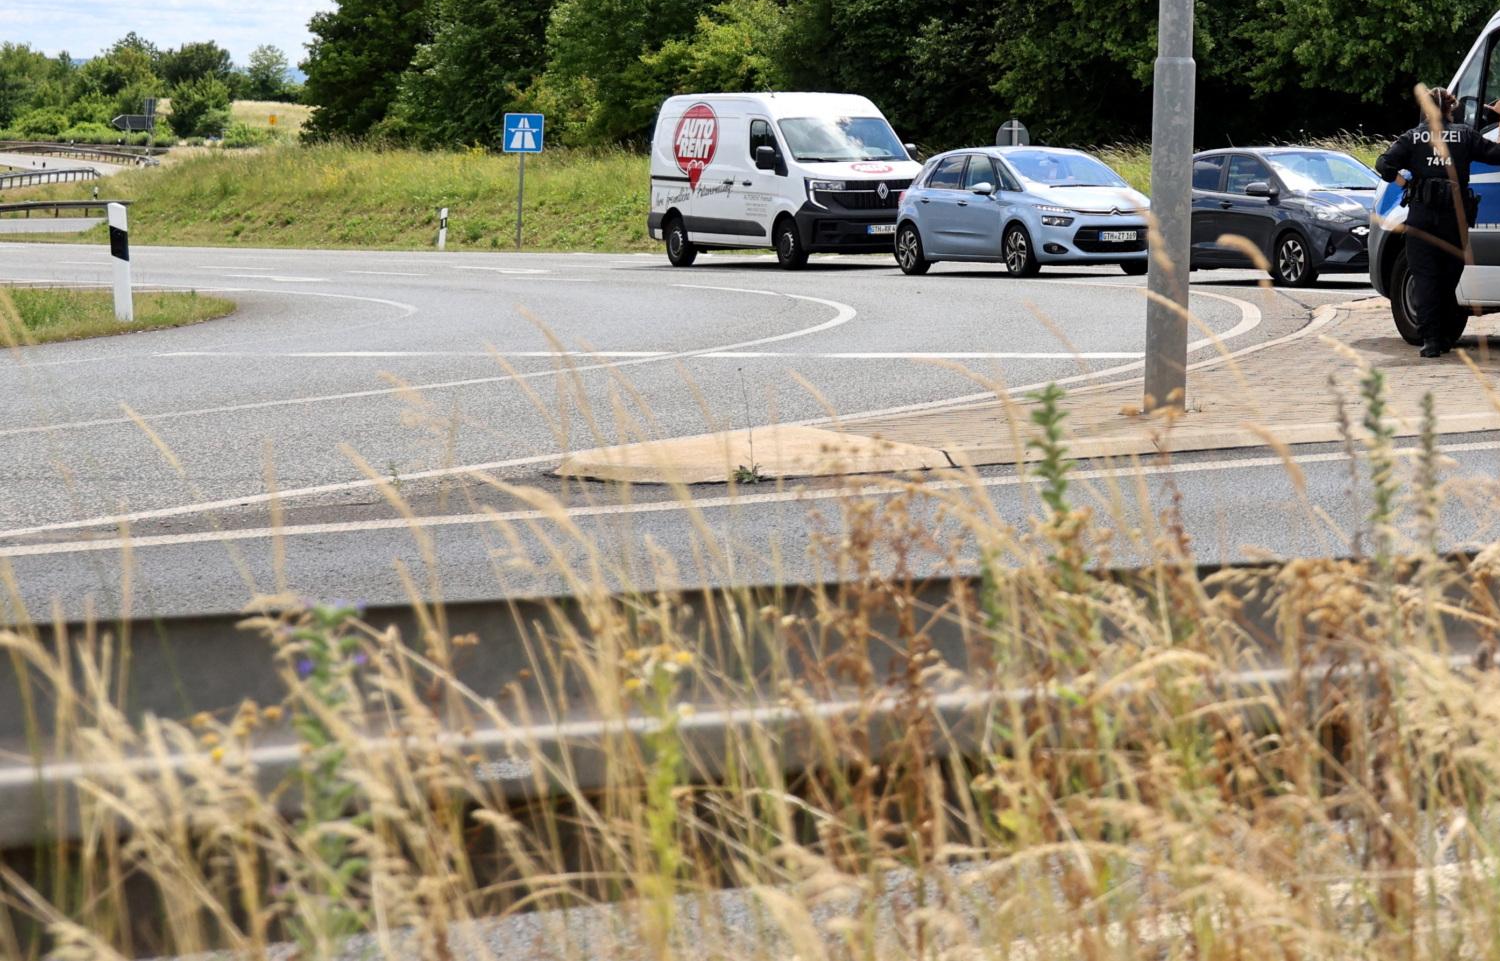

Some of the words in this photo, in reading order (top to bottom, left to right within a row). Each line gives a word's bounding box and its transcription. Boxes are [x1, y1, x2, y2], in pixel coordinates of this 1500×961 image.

[677, 119, 715, 143] AUTO
[1413, 130, 1461, 144] POLIZEI
[678, 138, 713, 159] RENT
[1426, 157, 1452, 166] 7414
